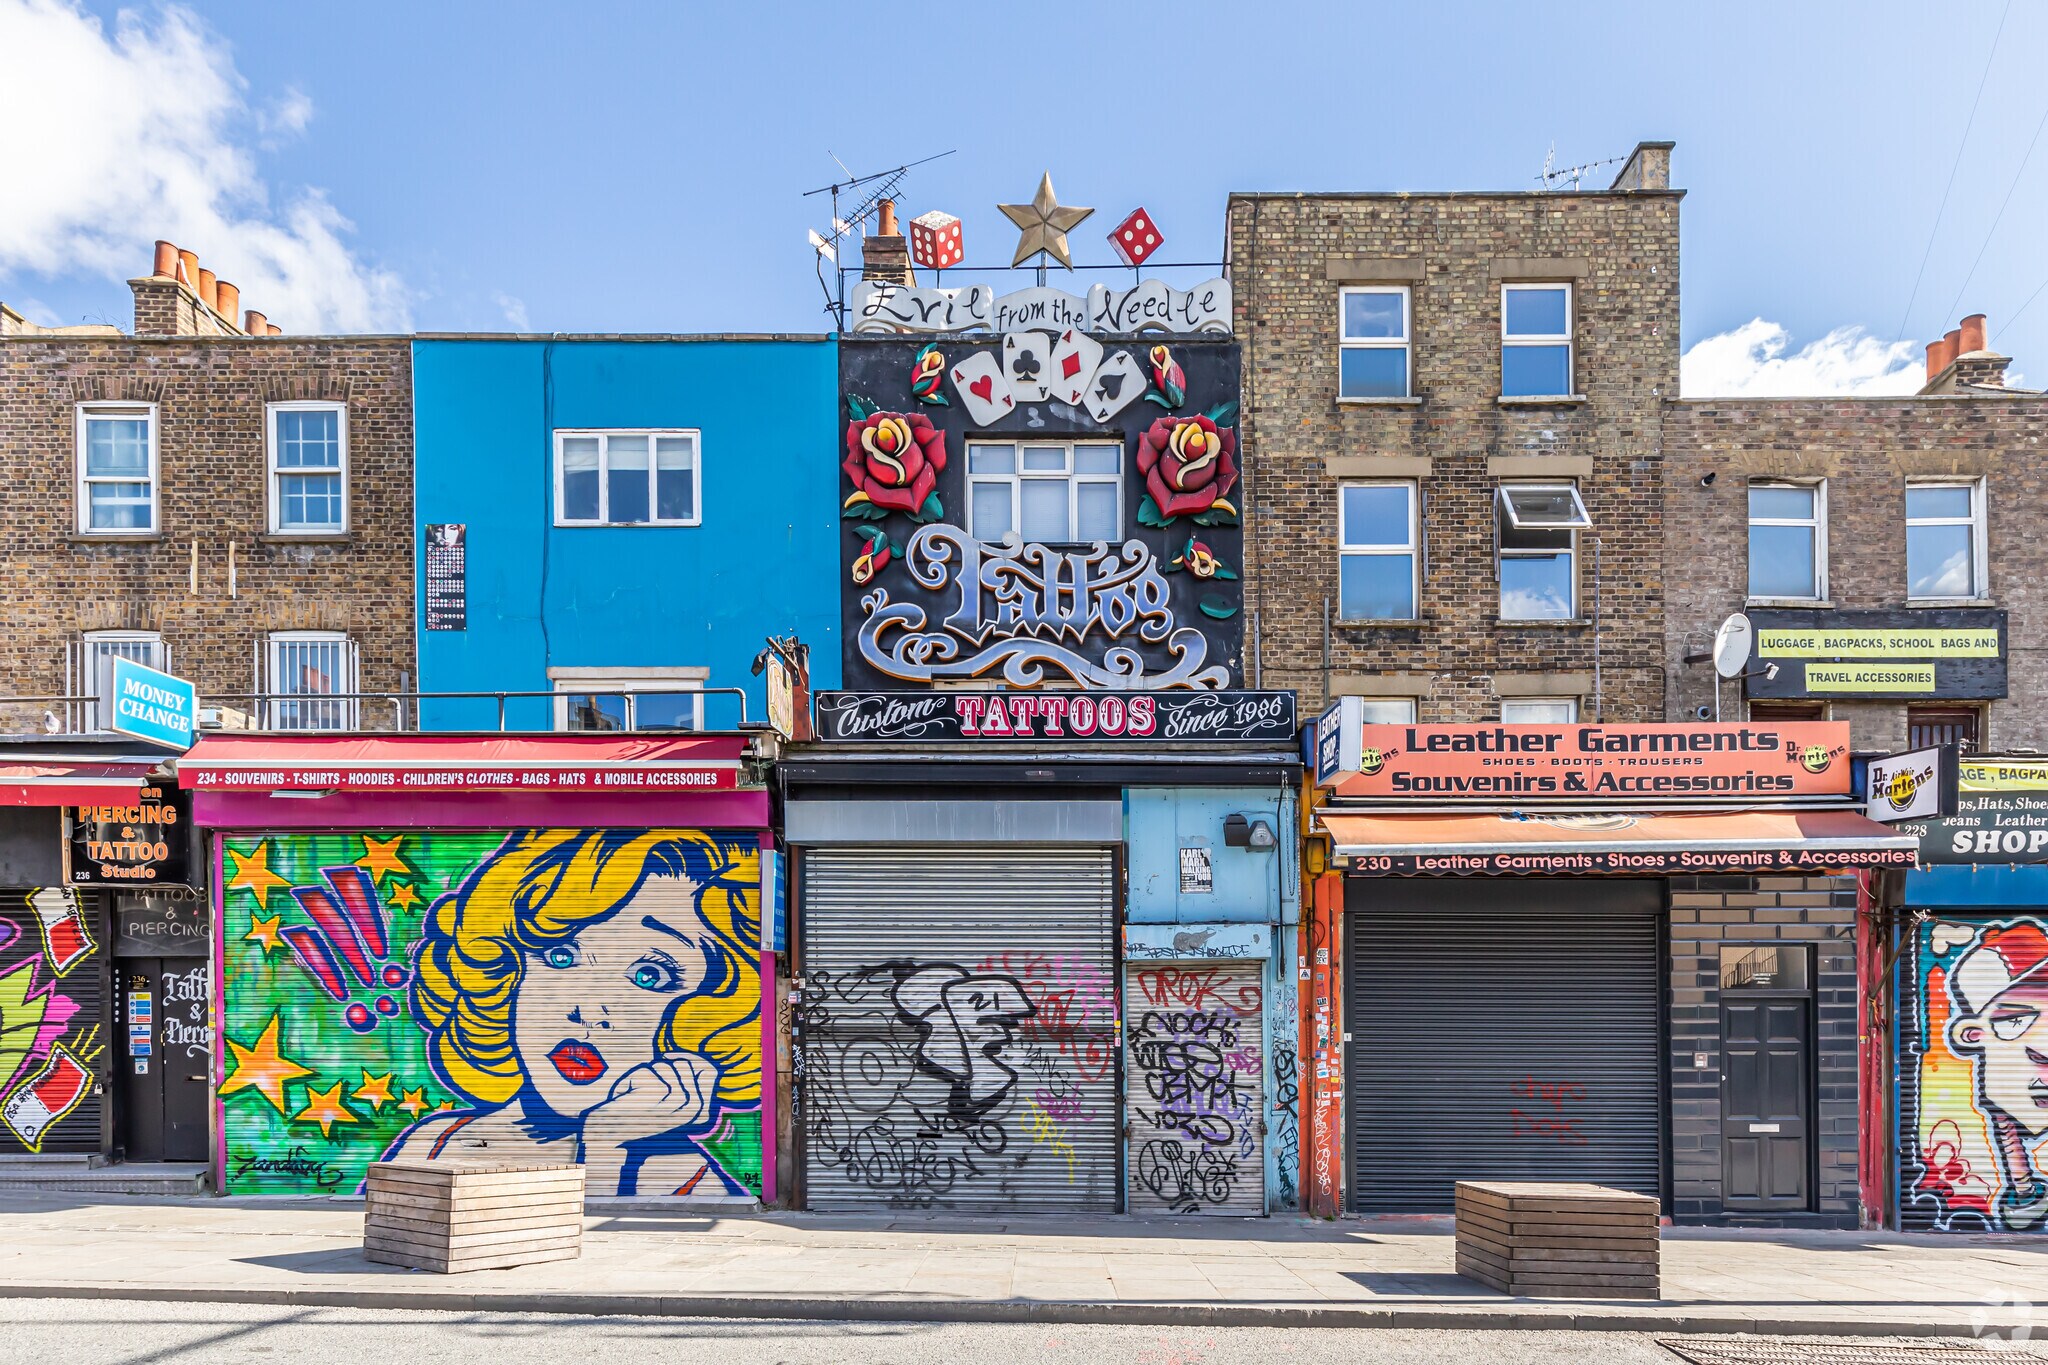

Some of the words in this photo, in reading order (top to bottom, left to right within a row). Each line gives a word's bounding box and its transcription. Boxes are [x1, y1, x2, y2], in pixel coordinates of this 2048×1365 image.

[862, 281, 986, 323] Evil
[995, 302, 1046, 328] from
[1051, 298, 1084, 331] the
[1093, 286, 1217, 331] Needle
[1761, 638, 1815, 648] LUGGAGE
[1824, 638, 1886, 650] BAGPACKS,
[1889, 638, 1935, 648] SCHOOL
[1940, 638, 1971, 648] BAGS
[1974, 638, 1997, 648] AND
[1809, 672, 1852, 683] TRAVEL
[1855, 672, 1932, 683] ACCESSORIES
[123, 677, 187, 712] MONEY
[118, 698, 189, 733] CHANGE
[832, 696, 947, 737] Custom
[955, 695, 1157, 736] TATTOOS
[1163, 704, 1229, 738] Since
[1234, 696, 1284, 725] 1986
[1405, 728, 1563, 753] Leather
[1579, 727, 1780, 753] Garments
[1362, 748, 1399, 762] rtens
[1482, 758, 1535, 766] SHOES
[1551, 758, 1603, 766] BOOTS
[1618, 757, 1703, 766] TROUSERS
[197, 773, 217, 785] 234
[225, 773, 284, 785] SOUVENIRS
[293, 773, 340, 785] T-SHIRTS
[348, 773, 395, 785] HOODIES
[403, 772, 464, 785] CHILDREN'S
[466, 773, 513, 784] CLOTHES
[522, 773, 550, 785] BAGS
[558, 773, 586, 785] HATS
[594, 773, 602, 785] &
[604, 773, 644, 785] MOBILE
[646, 773, 717, 785] ACCESSORIES
[1392, 771, 1558, 792] Souvenirs
[1563, 771, 1588, 792] &
[1594, 770, 1795, 792] Accessories
[1872, 765, 1934, 799] Martens
[1959, 769, 1986, 780] AGE
[1999, 768, 2048, 779] BAGPA
[78, 805, 177, 824] PIERCING
[121, 826, 136, 839] &
[1905, 825, 1927, 836] 228
[88, 841, 168, 860] TATTOO
[1952, 830, 2048, 853] SHOP
[1356, 856, 1391, 870] 230
[1416, 855, 1489, 870] Leather
[1494, 853, 1593, 869] Garments
[1607, 852, 1665, 867] Shoes
[1680, 851, 1773, 866] Souvenirs
[1779, 851, 1793, 864] &
[1798, 850, 1915, 865] Accessories
[76, 871, 90, 880] 236
[101, 864, 156, 878] Studio
[132, 975, 146, 983] 236
[162, 967, 210, 1007] Tatt
[164, 1016, 209, 1044] Pierc
